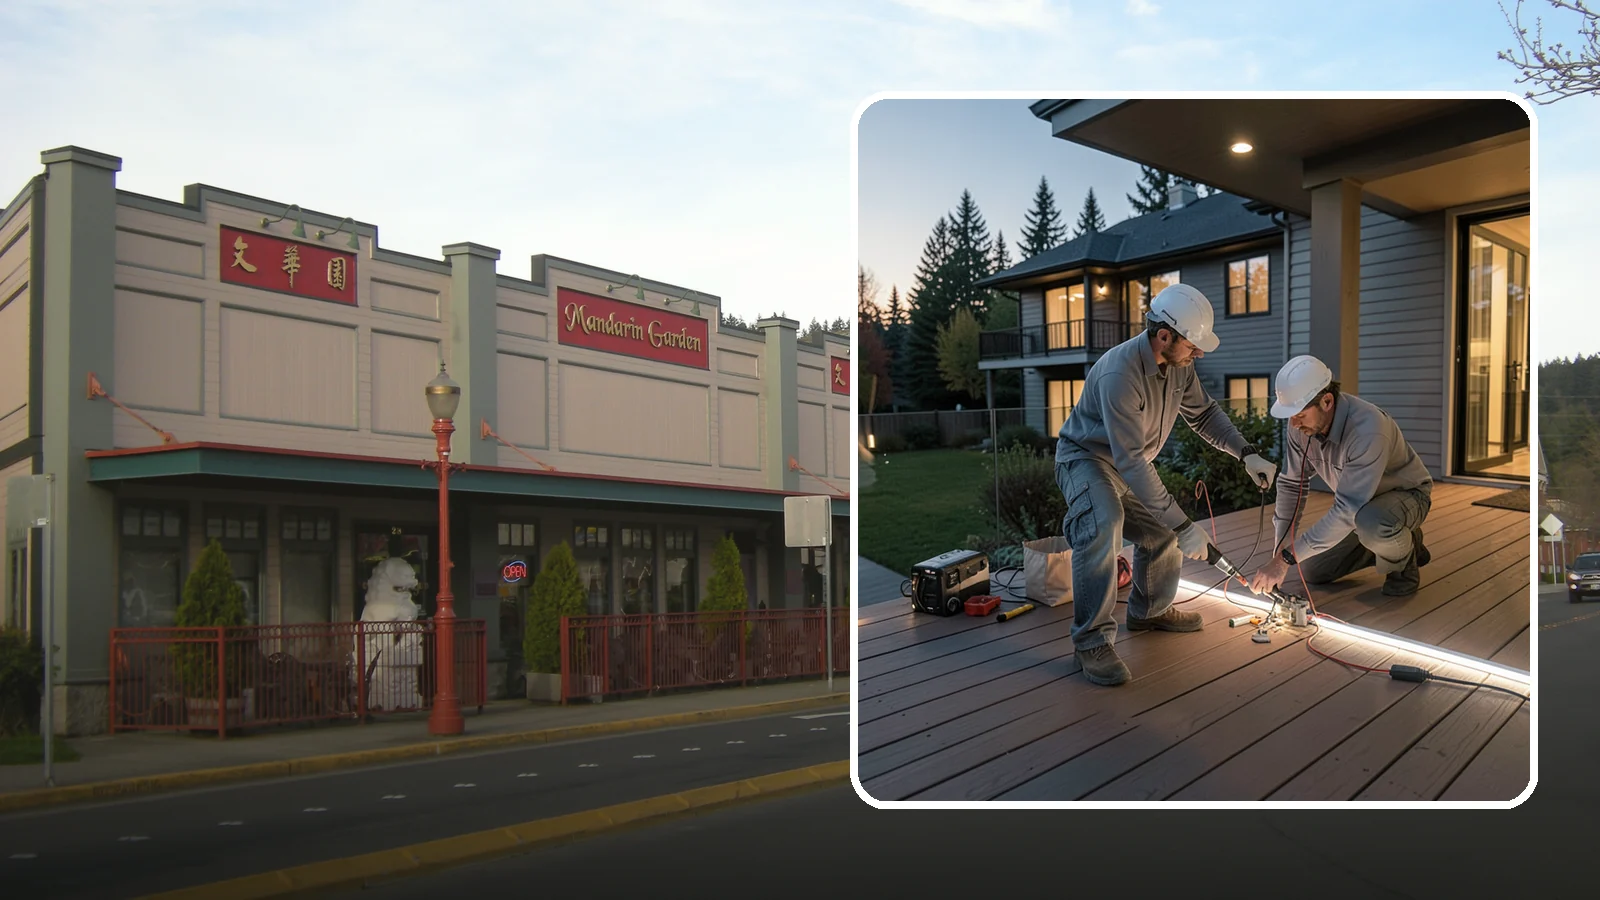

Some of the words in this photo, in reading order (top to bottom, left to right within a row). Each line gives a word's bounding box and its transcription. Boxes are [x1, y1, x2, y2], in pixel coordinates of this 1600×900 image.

[564, 302, 644, 341] Mandarin
[647, 320, 702, 352] Garden
[503, 565, 527, 578] OPEN
